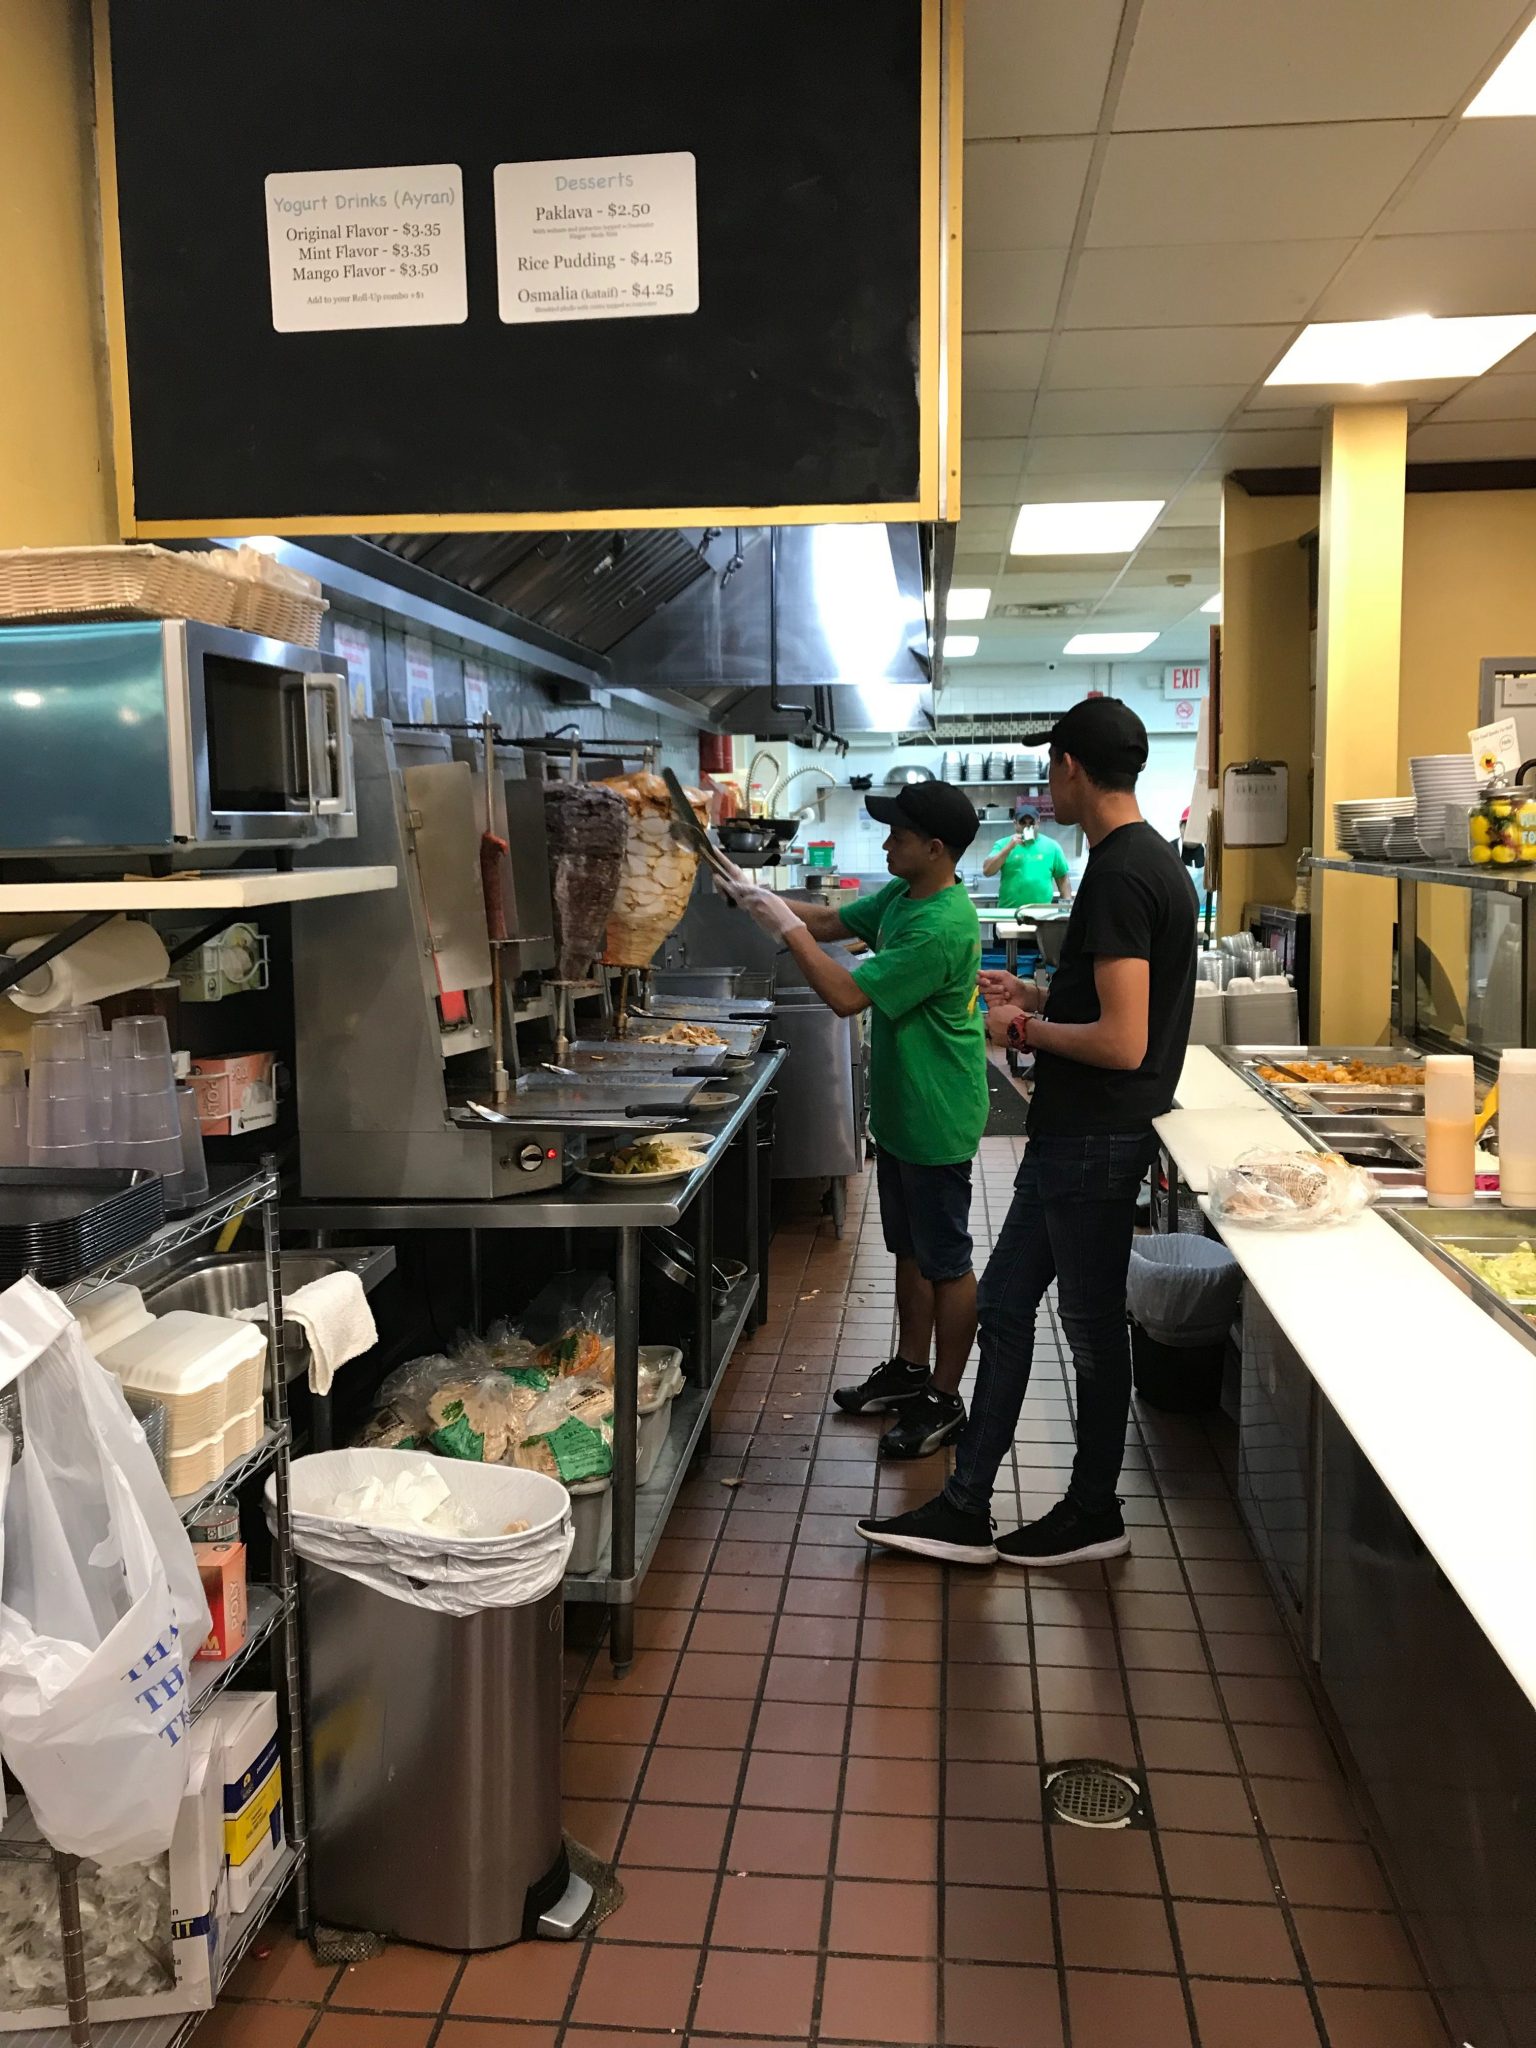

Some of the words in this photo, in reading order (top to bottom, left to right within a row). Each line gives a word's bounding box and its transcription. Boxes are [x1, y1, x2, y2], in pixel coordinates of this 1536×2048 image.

[555, 172, 634, 192] Desserts
[273, 195, 328, 217] Yogurt
[335, 192, 388, 210] Drinks
[394, 187, 455, 210] (Ayran)
[536, 204, 593, 221] Paklava
[607, 202, 651, 218] $2.50
[286, 225, 341, 243] Original
[346, 224, 389, 239] Flavor
[402, 222, 441, 238] $3.35
[299, 247, 331, 260] Mint
[336, 245, 379, 259] Flavor
[392, 243, 431, 258] $3.35
[518, 257, 550, 271] Rice
[554, 252, 616, 269] Pudding
[630, 250, 673, 266] $4.25
[292, 267, 339, 283] Mango
[343, 264, 386, 279] Flavor
[400, 262, 439, 277] $3.50
[307, 295, 322, 304] Add
[324, 295, 332, 304] to
[333, 295, 351, 305] your
[383, 291, 409, 300] combo
[518, 286, 578, 303] Osmalia
[581, 287, 619, 301] (kataif)
[632, 282, 674, 298] $4.25
[1173, 668, 1201, 689] EXIT
[229, 1581, 240, 1630] POLY
